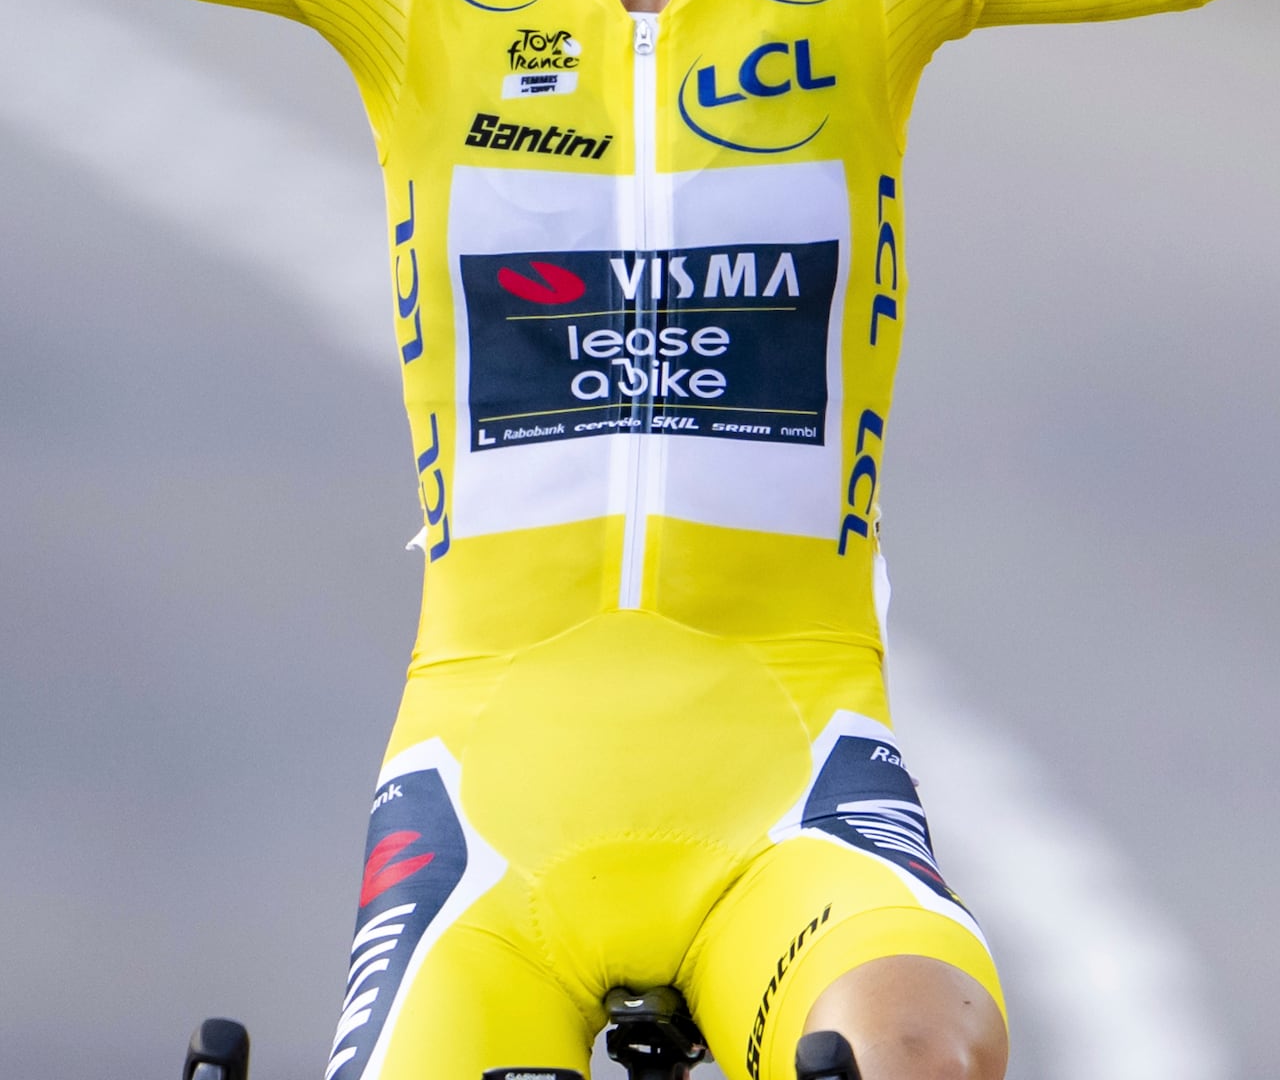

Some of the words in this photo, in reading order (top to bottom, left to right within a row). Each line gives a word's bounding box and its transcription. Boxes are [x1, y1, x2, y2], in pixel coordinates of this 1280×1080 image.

[696, 38, 837, 108] LCL
[464, 112, 614, 161] Santini
[395, 180, 424, 364] LCL
[610, 252, 800, 300] VISMA
[870, 174, 898, 346] LCL
[568, 325, 730, 360] lease
[503, 423, 565, 440] Rabobank
[651, 416, 699, 430] SKIL
[711, 423, 771, 435] SRAM
[780, 427, 817, 438] nimbl
[418, 412, 450, 563] LCL
[837, 408, 884, 556] LCL
